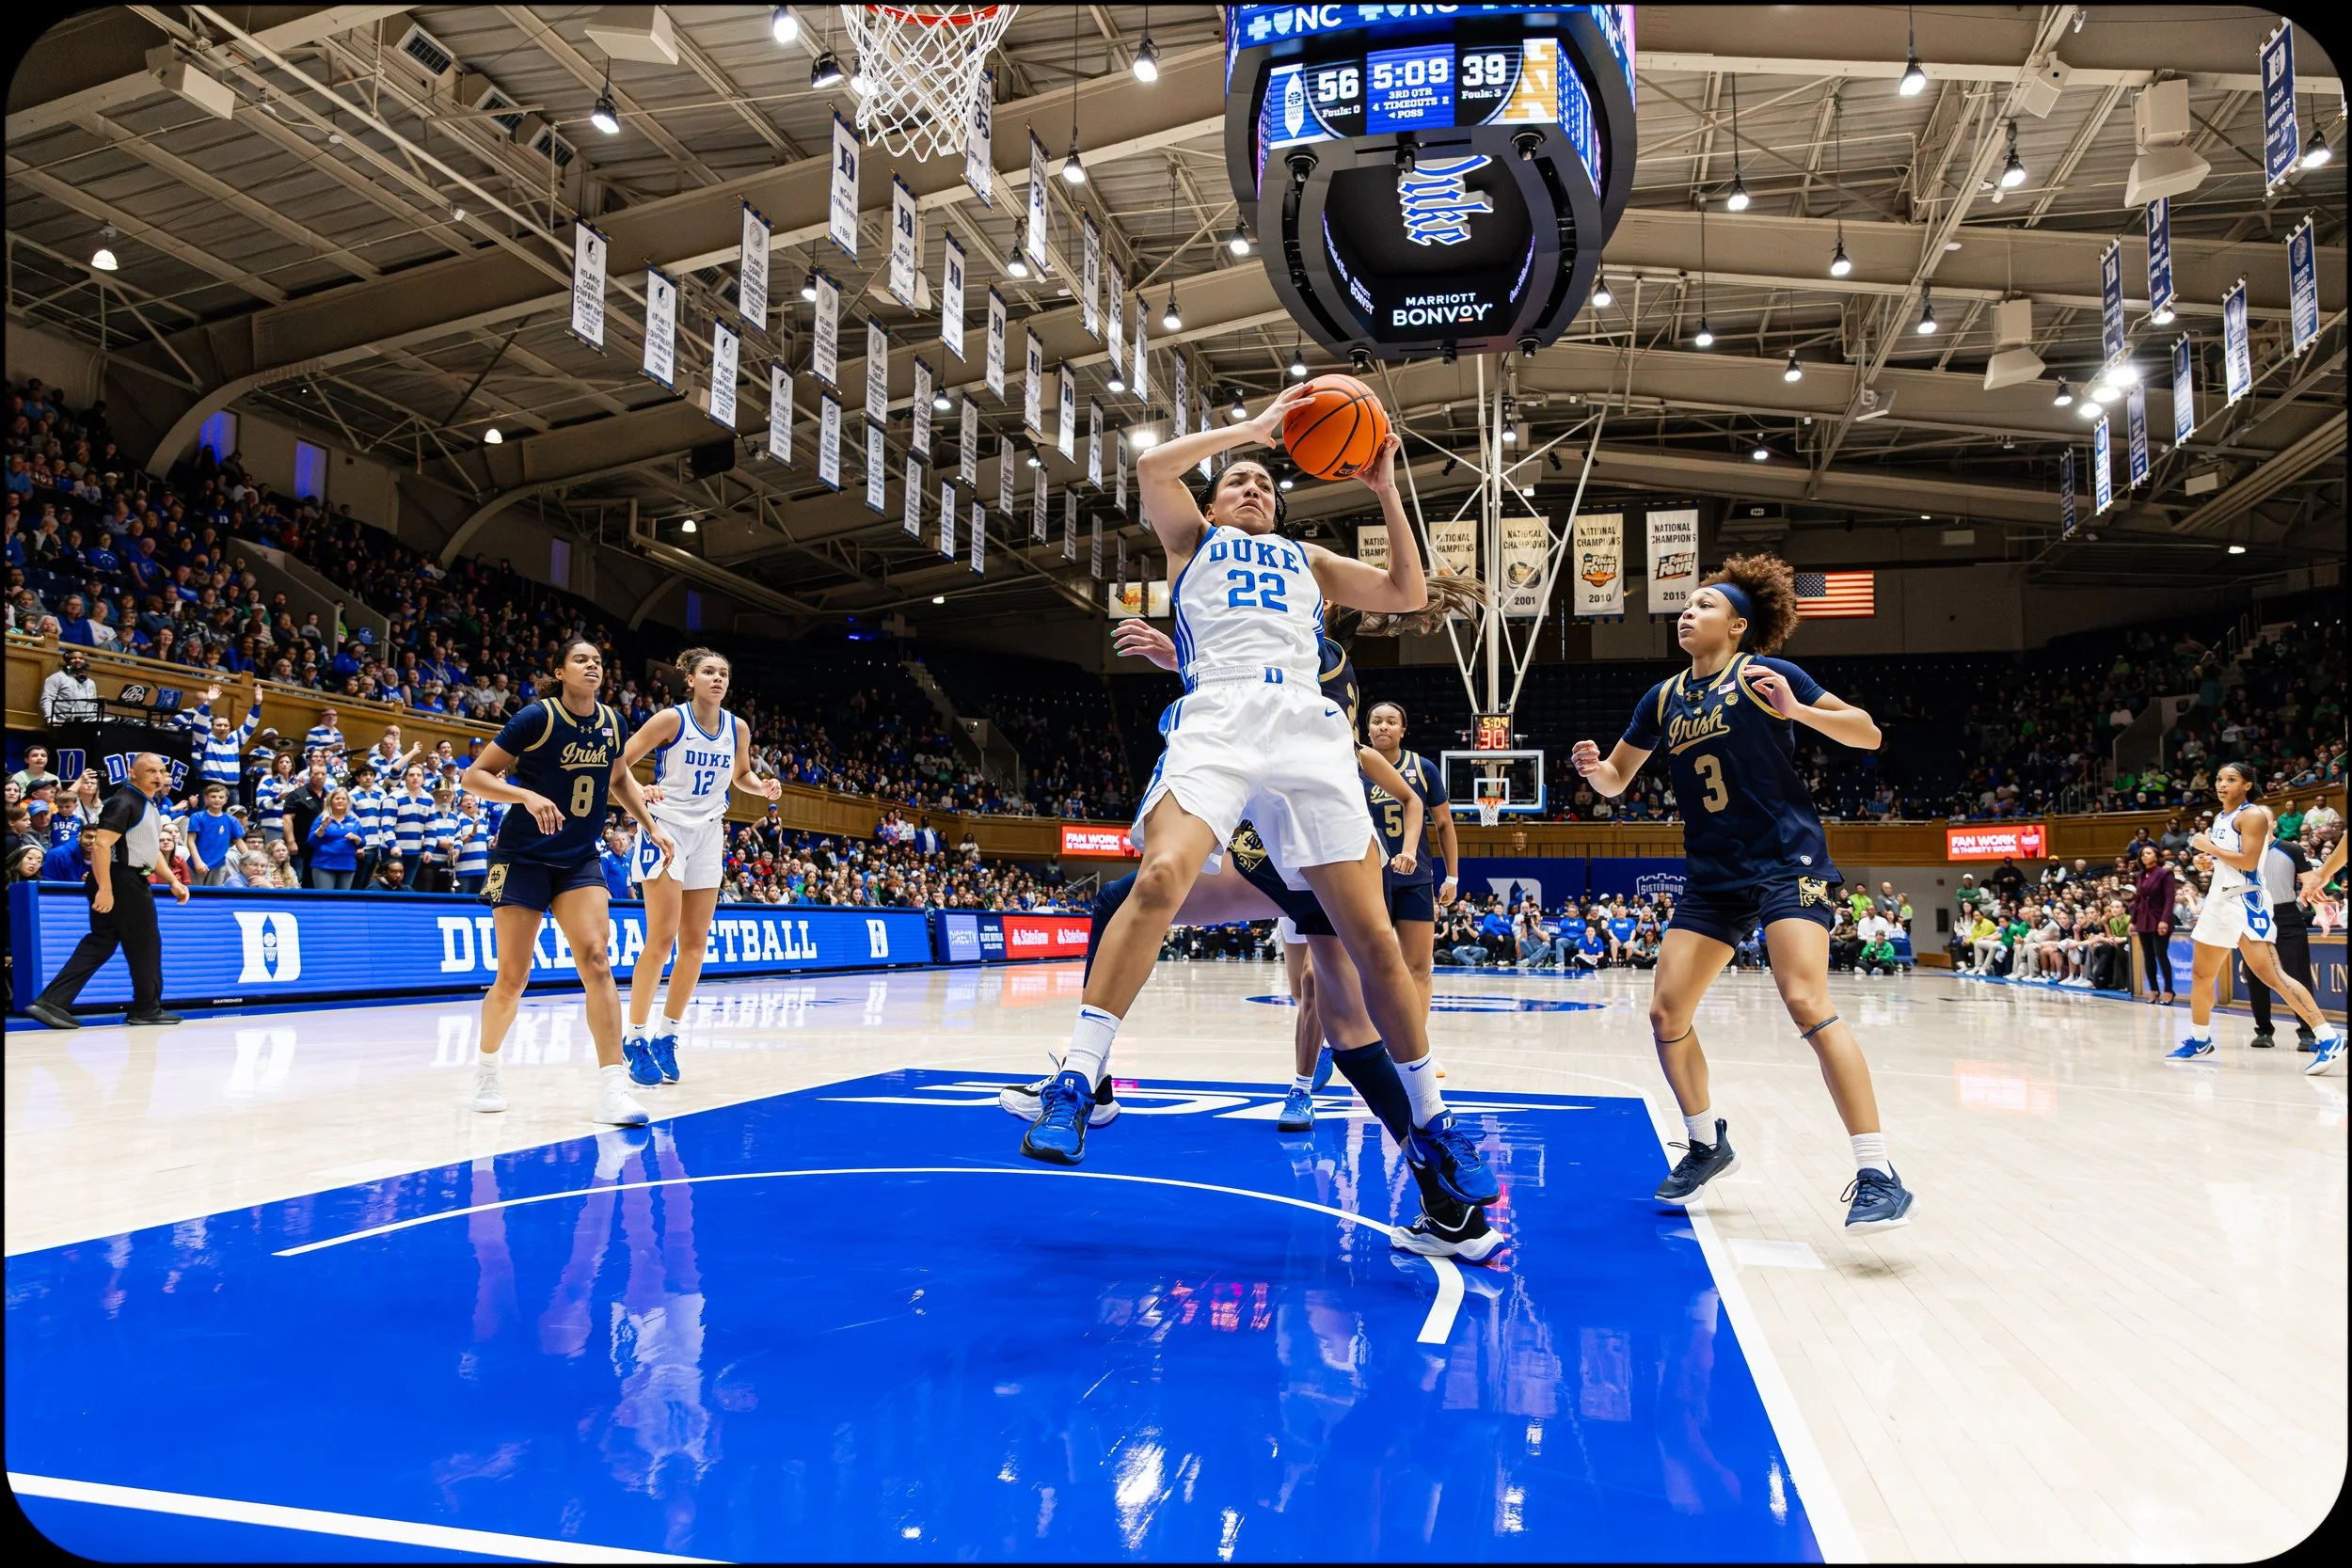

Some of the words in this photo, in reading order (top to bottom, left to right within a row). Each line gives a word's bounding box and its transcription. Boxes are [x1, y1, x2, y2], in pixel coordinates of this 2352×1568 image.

[1295, 5, 1343, 32] NC
[1374, 58, 1449, 88] 5:09
[1462, 55, 1506, 87] 39
[1318, 69, 1359, 102] 56
[1389, 89, 1408, 99] 3RD
[1411, 88, 1433, 98] QTR
[1461, 89, 1494, 100] Fouls:
[1373, 103, 1379, 111] 4
[1383, 98, 1438, 109] TIMEOUTS
[1322, 107, 1352, 119] Fouls:
[1397, 109, 1424, 119] POSS
[1406, 293, 1476, 306] MARRIOTT
[1393, 304, 1488, 326] BONVOY
[1581, 527, 1616, 536] NATIONAL
[1654, 523, 1691, 532] NATIONAL
[1577, 536, 1620, 547] CHAMPIONS
[1651, 533, 1696, 544] CHAMPIONS
[1437, 544, 1474, 553] HAMPIONS
[1209, 539, 1299, 574] DUKE
[1593, 555, 1616, 564] FINAL
[1670, 553, 1694, 564] FINAL
[1583, 564, 1616, 575] FOUR
[1660, 563, 1693, 577] FOUR
[1228, 569, 1288, 612] 22
[1663, 592, 1686, 600] 2015
[1515, 596, 1535, 605] 2001
[1589, 594, 1611, 603] 2010
[1264, 666, 1283, 685] D
[1483, 717, 1508, 728] 5:09
[1669, 705, 1730, 752] Irish
[1481, 730, 1504, 749] 30
[560, 741, 608, 768] Irish
[685, 750, 731, 768] DUKE
[691, 770, 716, 796] 12
[1694, 753, 1728, 813] 3
[570, 775, 595, 817] 8
[53, 821, 79, 832] DUKE
[1384, 804, 1403, 837] 5
[60, 830, 71, 841] 3
[1066, 833, 1086, 843] FAN
[1088, 834, 1119, 845] WORK
[1951, 835, 1975, 847] FAN
[1977, 834, 2016, 846] WORK
[643, 849, 655, 863] D
[2252, 918, 2267, 929] D
[866, 919, 889, 958] D
[233, 911, 301, 983] D
